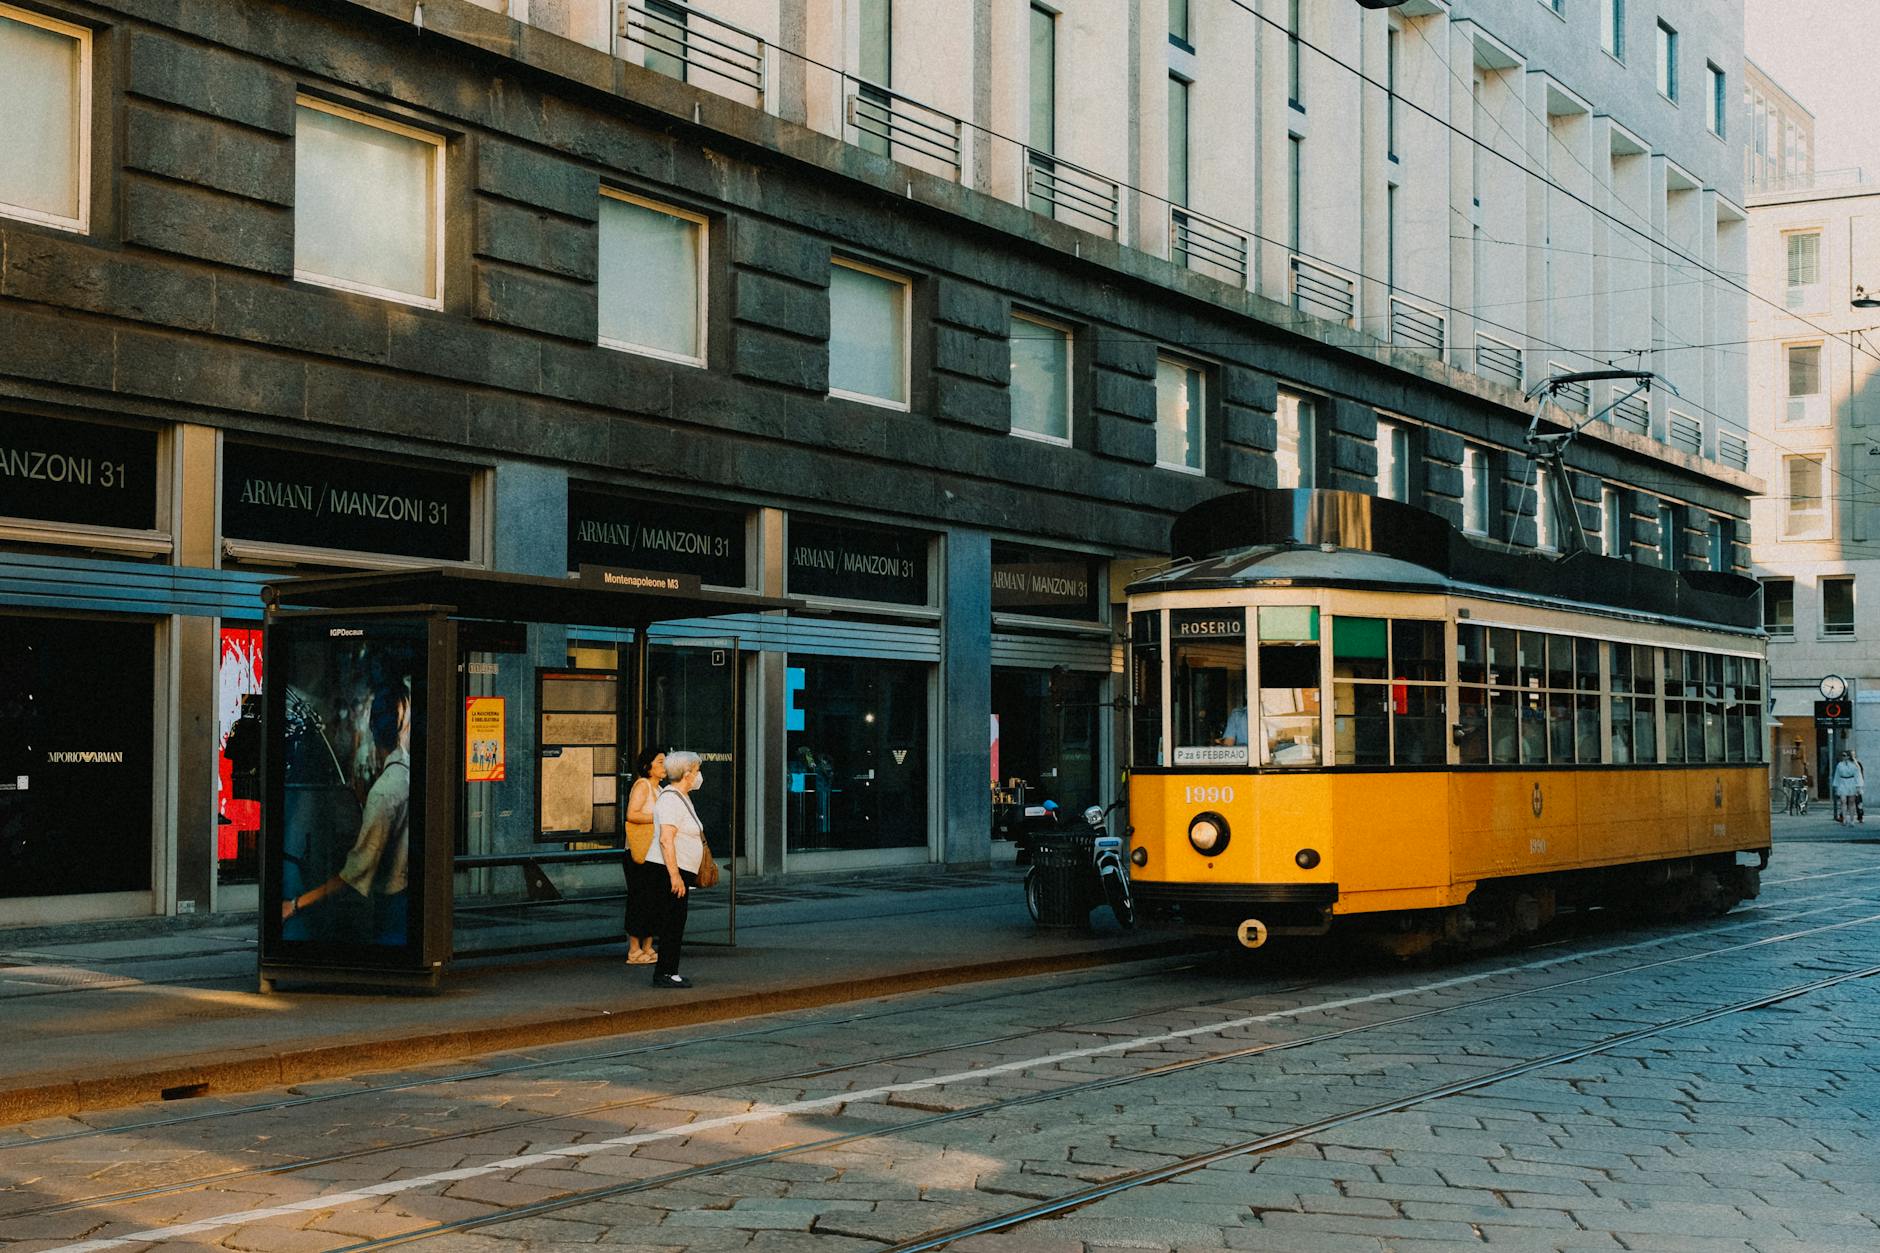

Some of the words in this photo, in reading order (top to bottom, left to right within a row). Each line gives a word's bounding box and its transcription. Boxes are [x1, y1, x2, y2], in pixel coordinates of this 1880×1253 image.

[0, 447, 92, 485] ANZONI
[100, 461, 125, 489] 31
[239, 479, 313, 510] ARMANI
[330, 488, 423, 523] MANZONI
[428, 501, 448, 526] 31
[577, 520, 630, 546] ARMANI
[642, 527, 711, 556] MANZONI
[714, 537, 730, 558] 31
[792, 546, 835, 569] ARMANI
[844, 552, 899, 577] MANZONI
[901, 560, 914, 578] 31
[604, 572, 666, 589] Montenapoleone
[667, 578, 680, 590] M3
[991, 571, 1025, 591] ARMANI
[1032, 575, 1077, 596] MANZONI
[1078, 581, 1088, 598] 31
[1181, 621, 1241, 635] ROSERIO
[91, 751, 123, 763] ARMANI
[1202, 749, 1245, 760] FEBBRAIO
[1185, 785, 1234, 805] 1990
